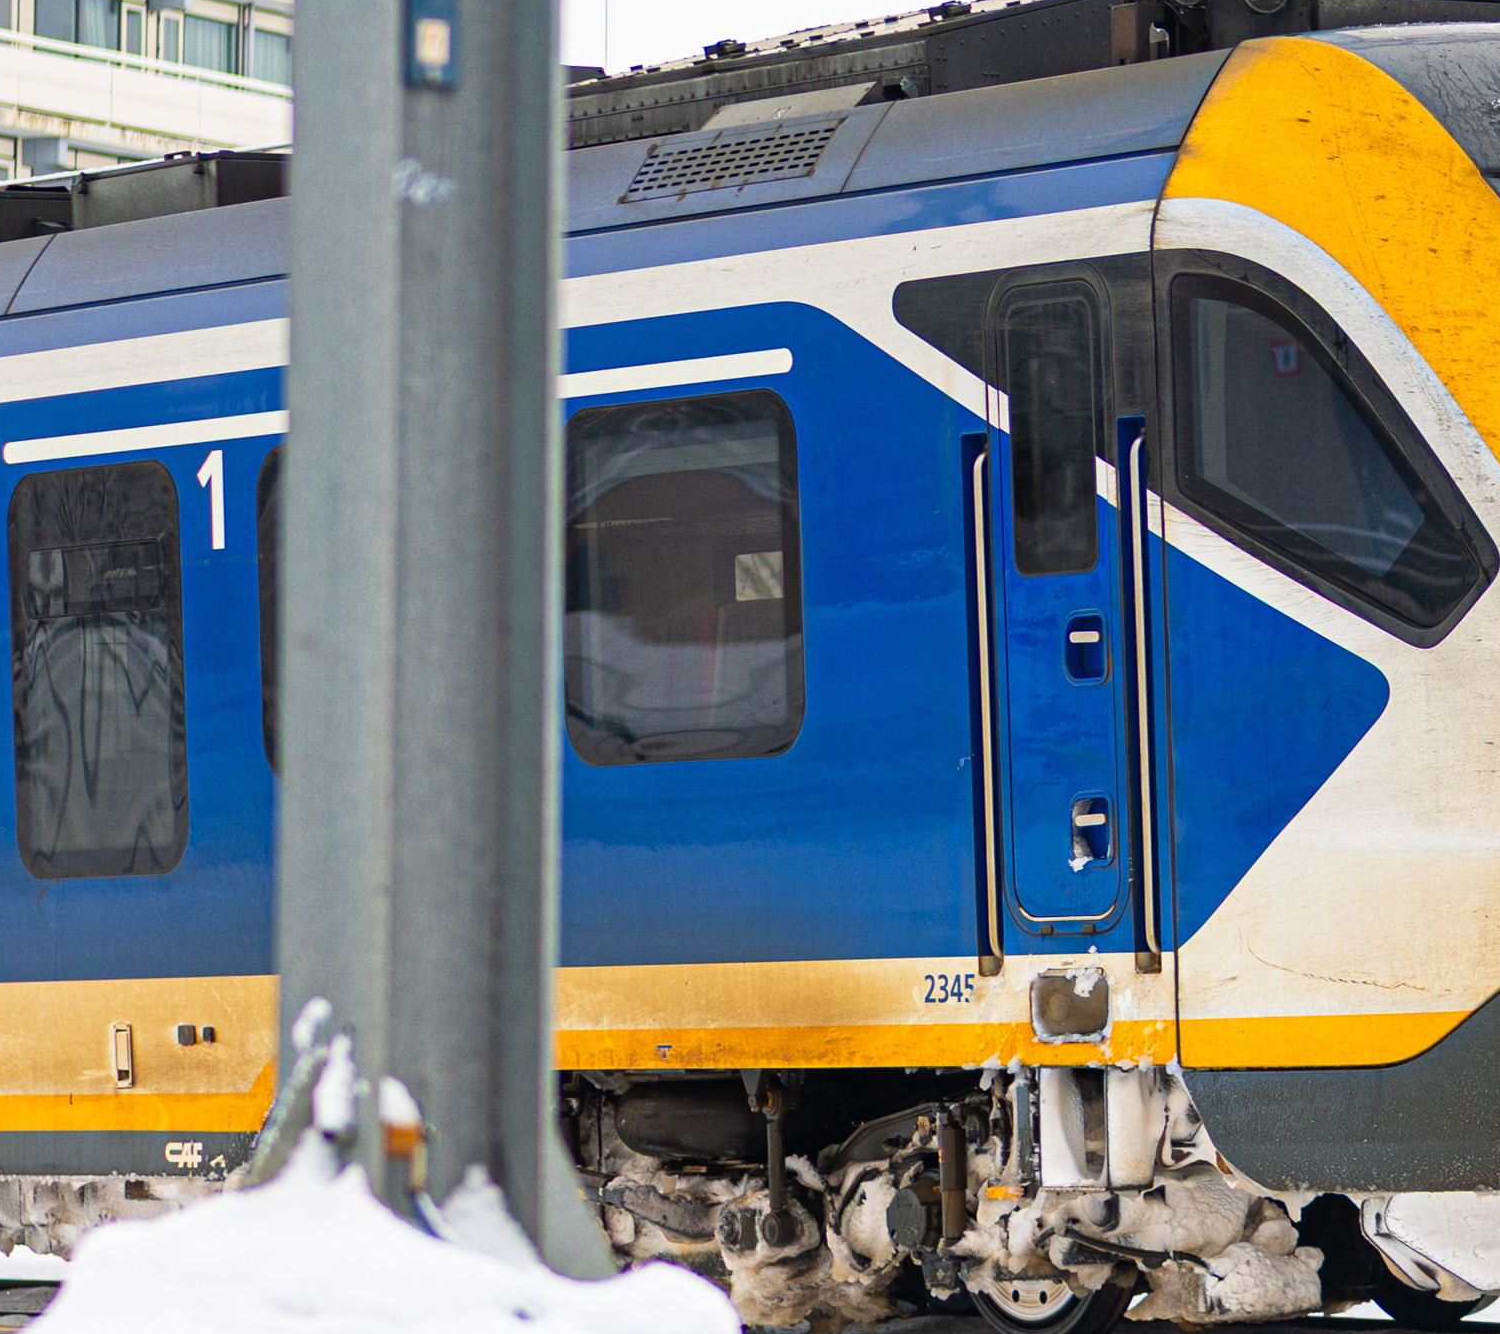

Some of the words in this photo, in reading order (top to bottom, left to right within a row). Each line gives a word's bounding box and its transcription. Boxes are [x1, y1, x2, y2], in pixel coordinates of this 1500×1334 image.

[196, 450, 225, 550] 1
[924, 974, 975, 1003] 2345
[165, 1142, 203, 1168] CAF
